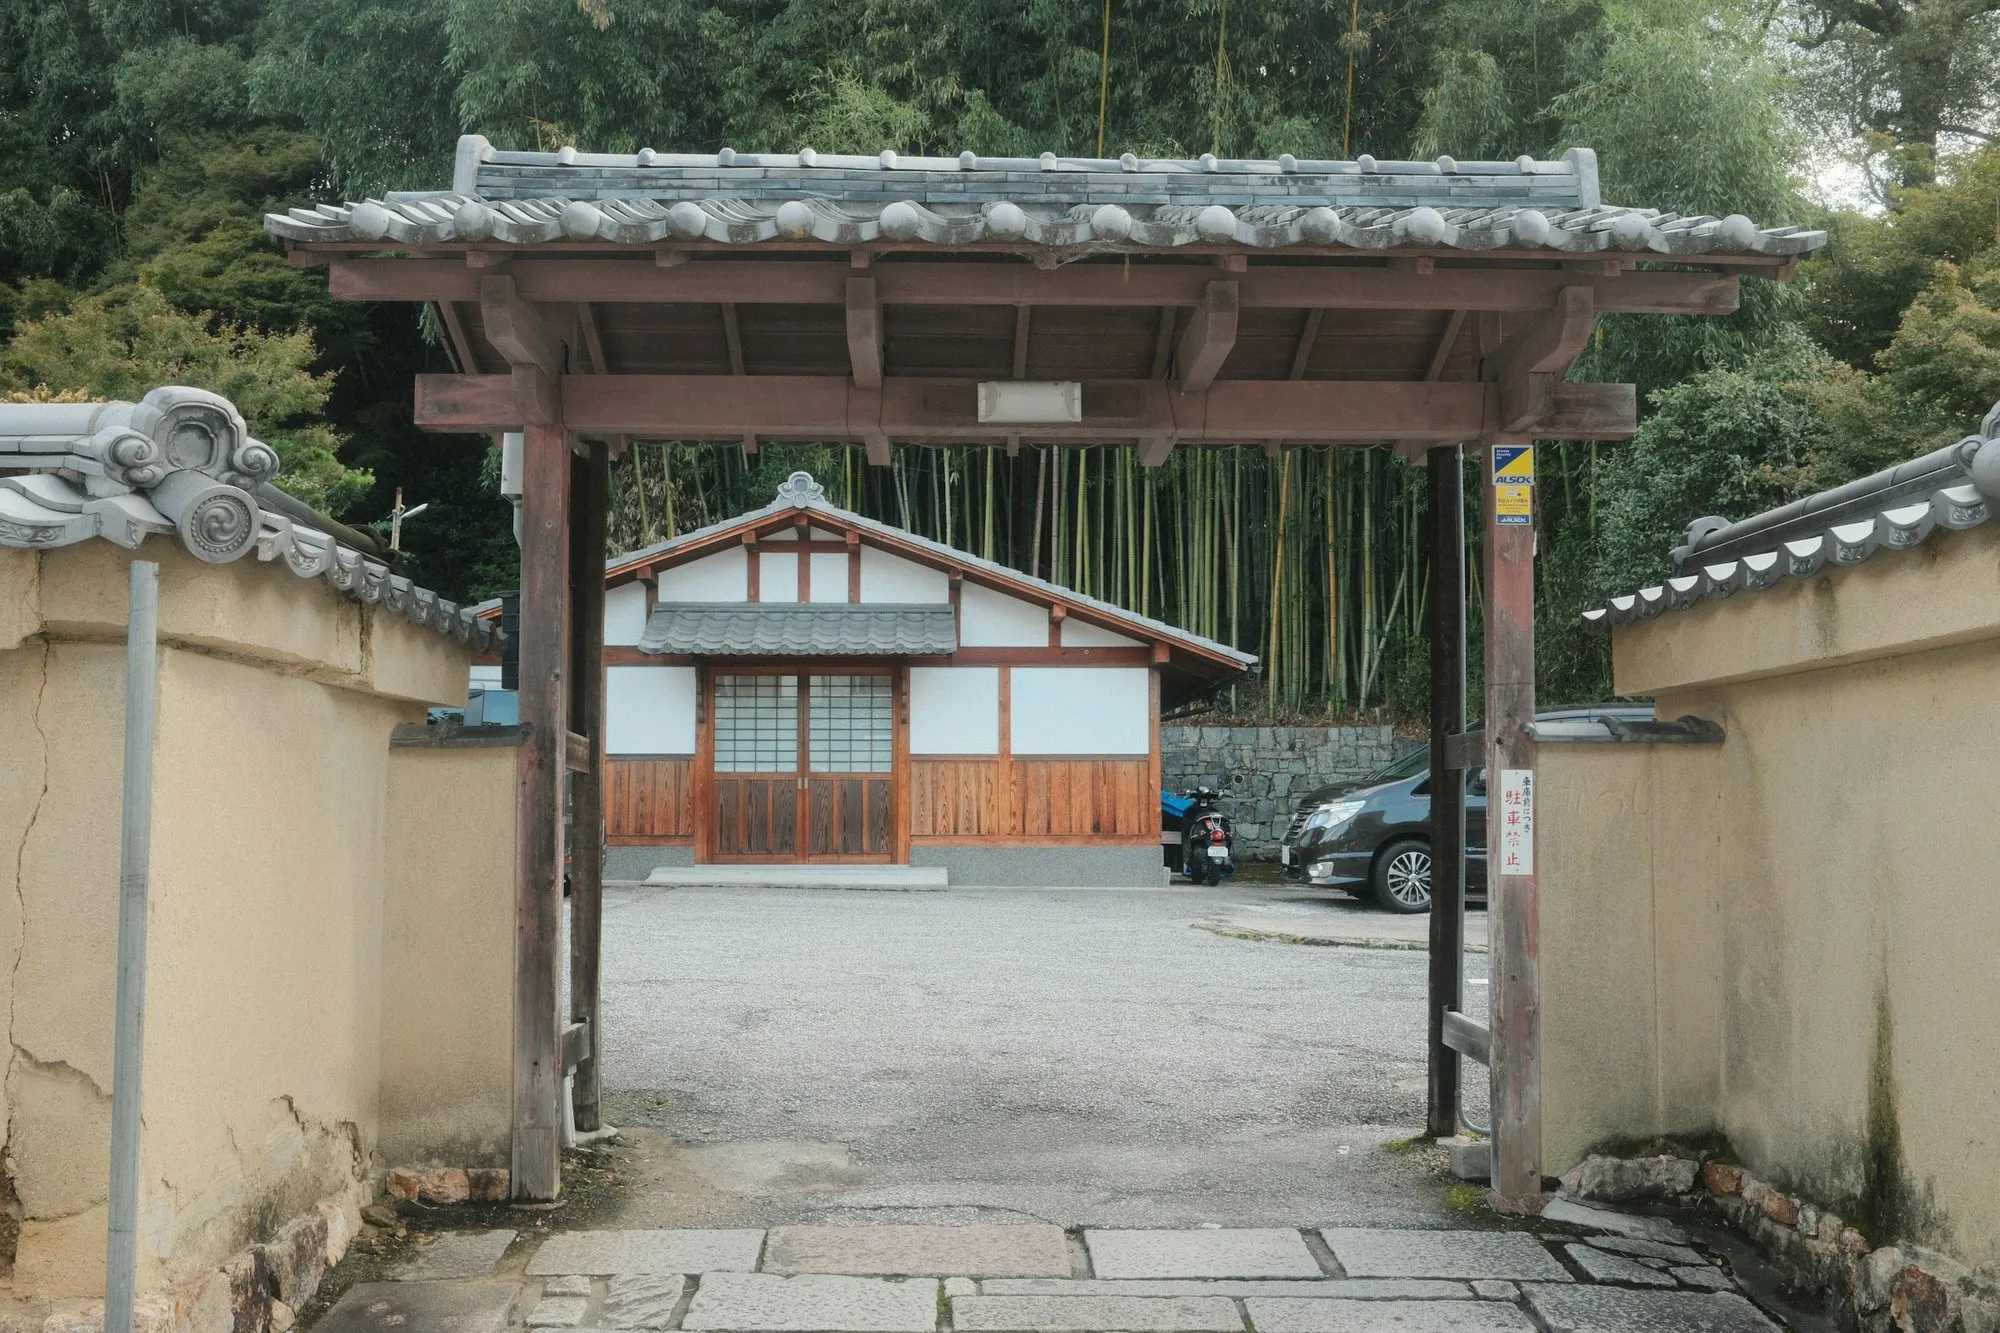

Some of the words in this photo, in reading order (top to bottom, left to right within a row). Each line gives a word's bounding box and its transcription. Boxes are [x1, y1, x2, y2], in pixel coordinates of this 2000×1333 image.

[1496, 476, 1531, 484] ALSOK
[1505, 790, 1521, 866] 駐車禁止
[1522, 776, 1531, 833] 車庫前につき
